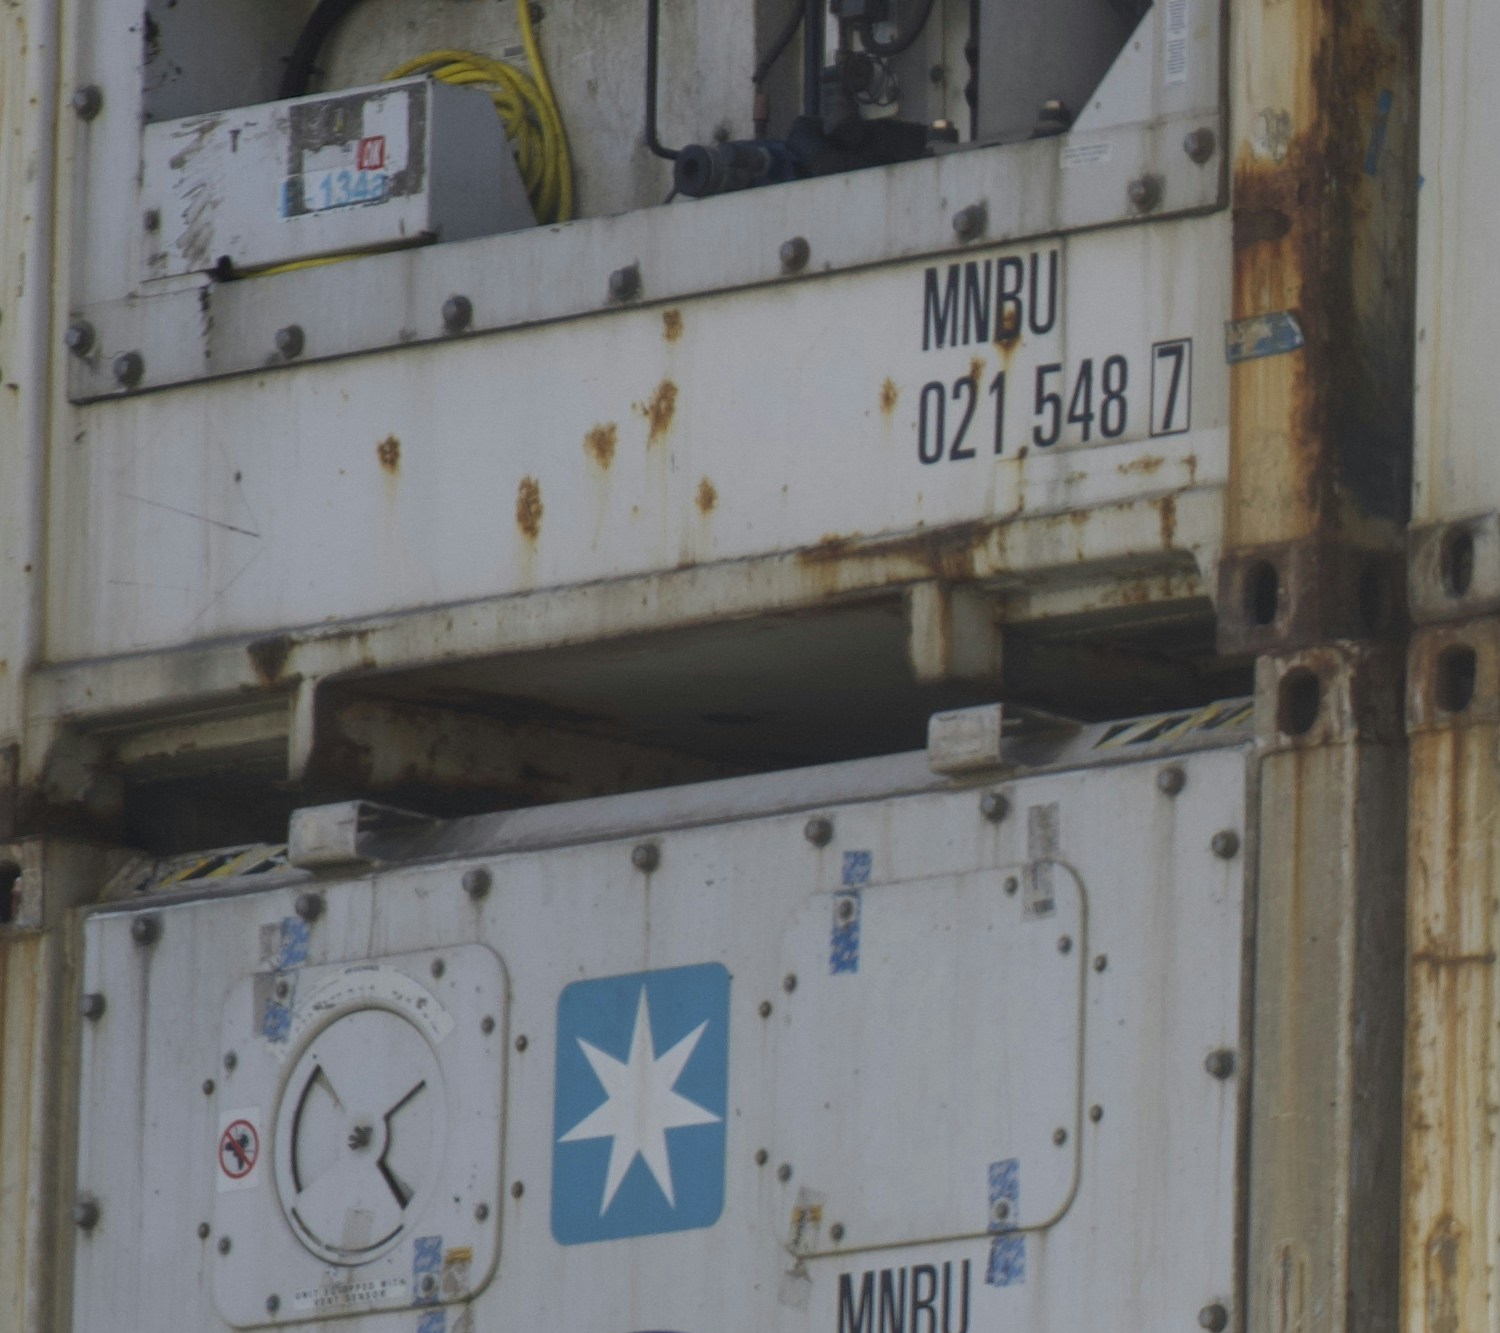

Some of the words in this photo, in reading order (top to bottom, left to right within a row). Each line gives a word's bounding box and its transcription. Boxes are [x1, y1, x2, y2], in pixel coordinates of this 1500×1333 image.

[922, 250, 1058, 351] MNBU
[918, 371, 1006, 465] 021
[1033, 355, 1128, 447] 548
[1155, 343, 1186, 432] 7
